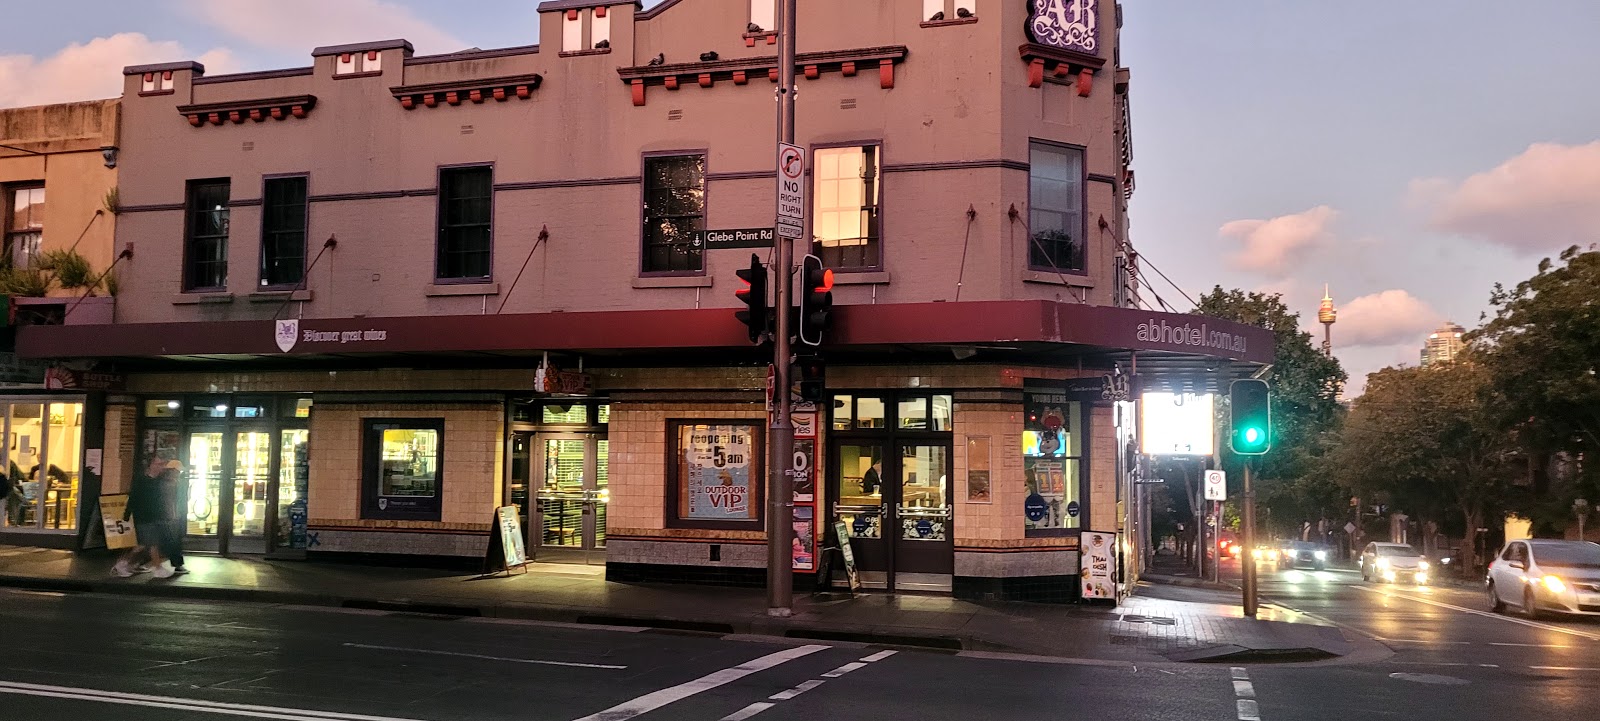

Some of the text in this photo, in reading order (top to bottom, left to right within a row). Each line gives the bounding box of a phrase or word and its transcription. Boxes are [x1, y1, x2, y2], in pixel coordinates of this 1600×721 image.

[784, 181, 799, 193] NO
[780, 194, 801, 204] RIGHT
[781, 204, 801, 215] TURN
[707, 230, 773, 242] Glebe Point Rd
[303, 328, 387, 343] Discover great wines
[1136, 318, 1247, 354] abhotel.com.au
[690, 433, 744, 445] reopening
[713, 445, 743, 468] 5 am
[705, 486, 746, 494] OUTDOOR
[709, 493, 742, 508] VIP
[115, 520, 124, 534] 5
[1091, 555, 1107, 564] THAI
